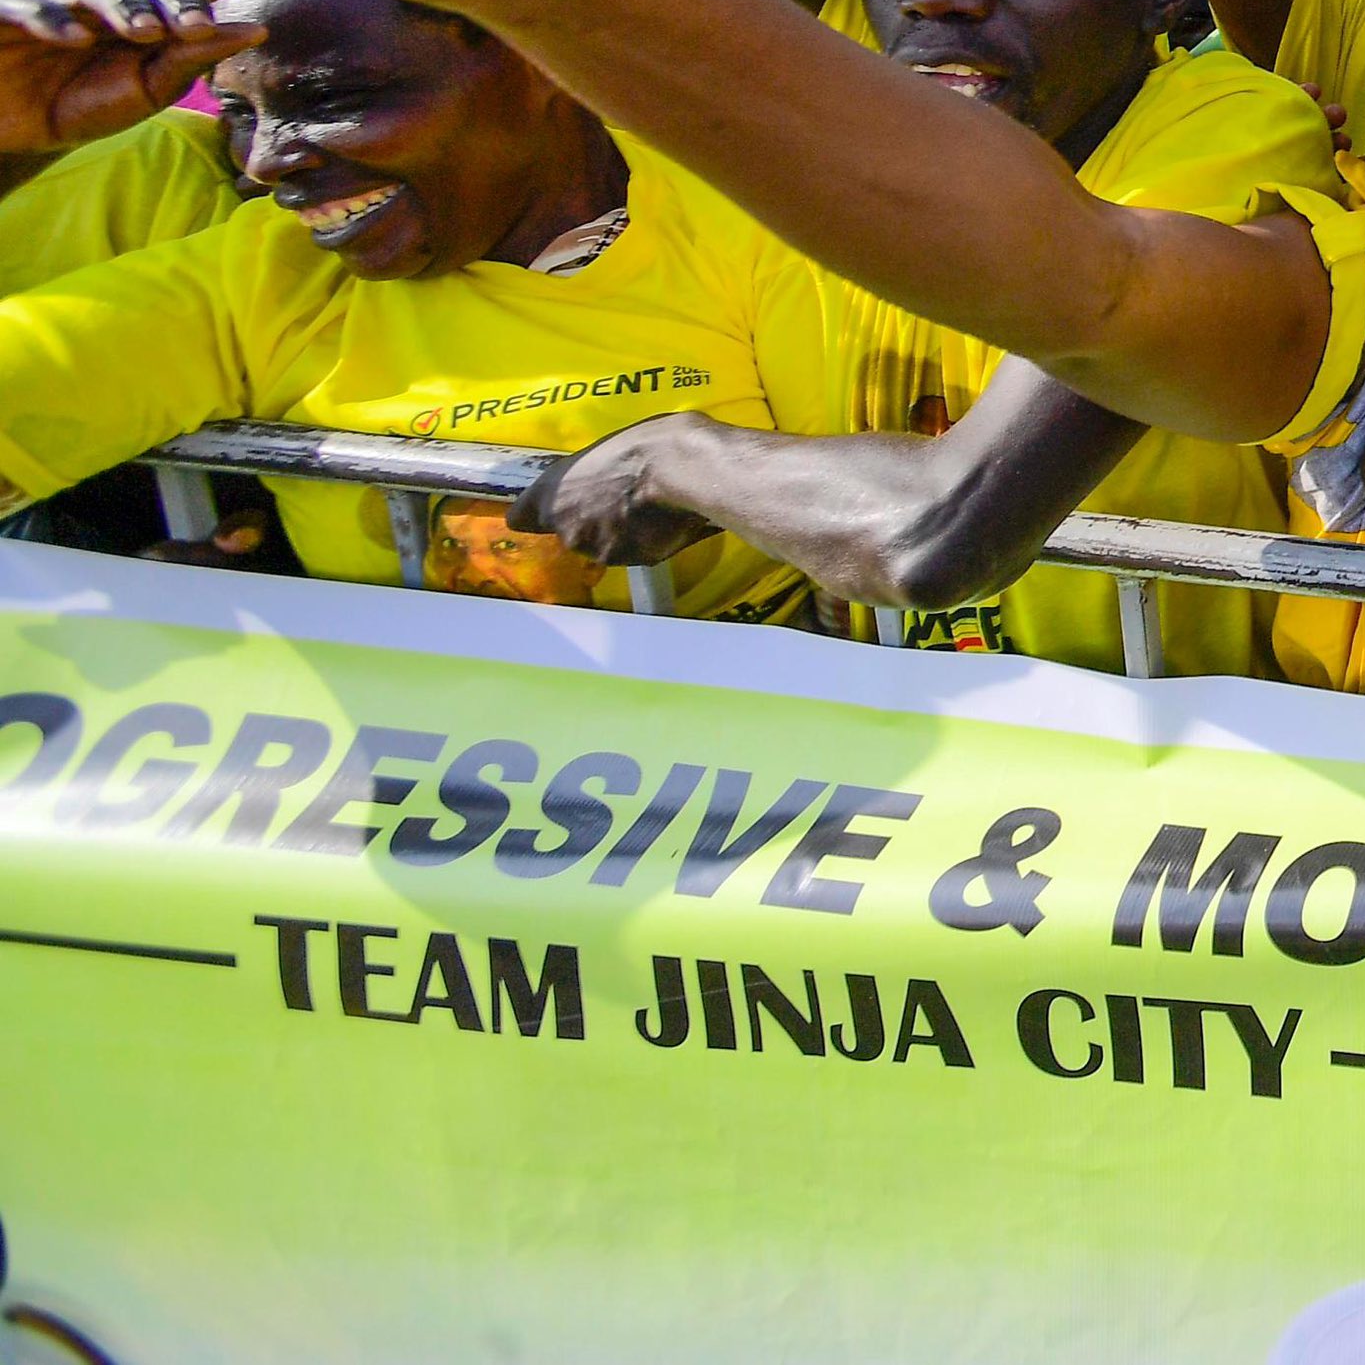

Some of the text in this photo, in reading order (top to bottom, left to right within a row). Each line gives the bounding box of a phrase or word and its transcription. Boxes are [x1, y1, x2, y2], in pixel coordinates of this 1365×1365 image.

[451, 367, 666, 428] PRESIDENT
[672, 374, 712, 389] 2031
[927, 806, 1063, 938] &
[253, 913, 1303, 1099] TEAM JINJA CITY
